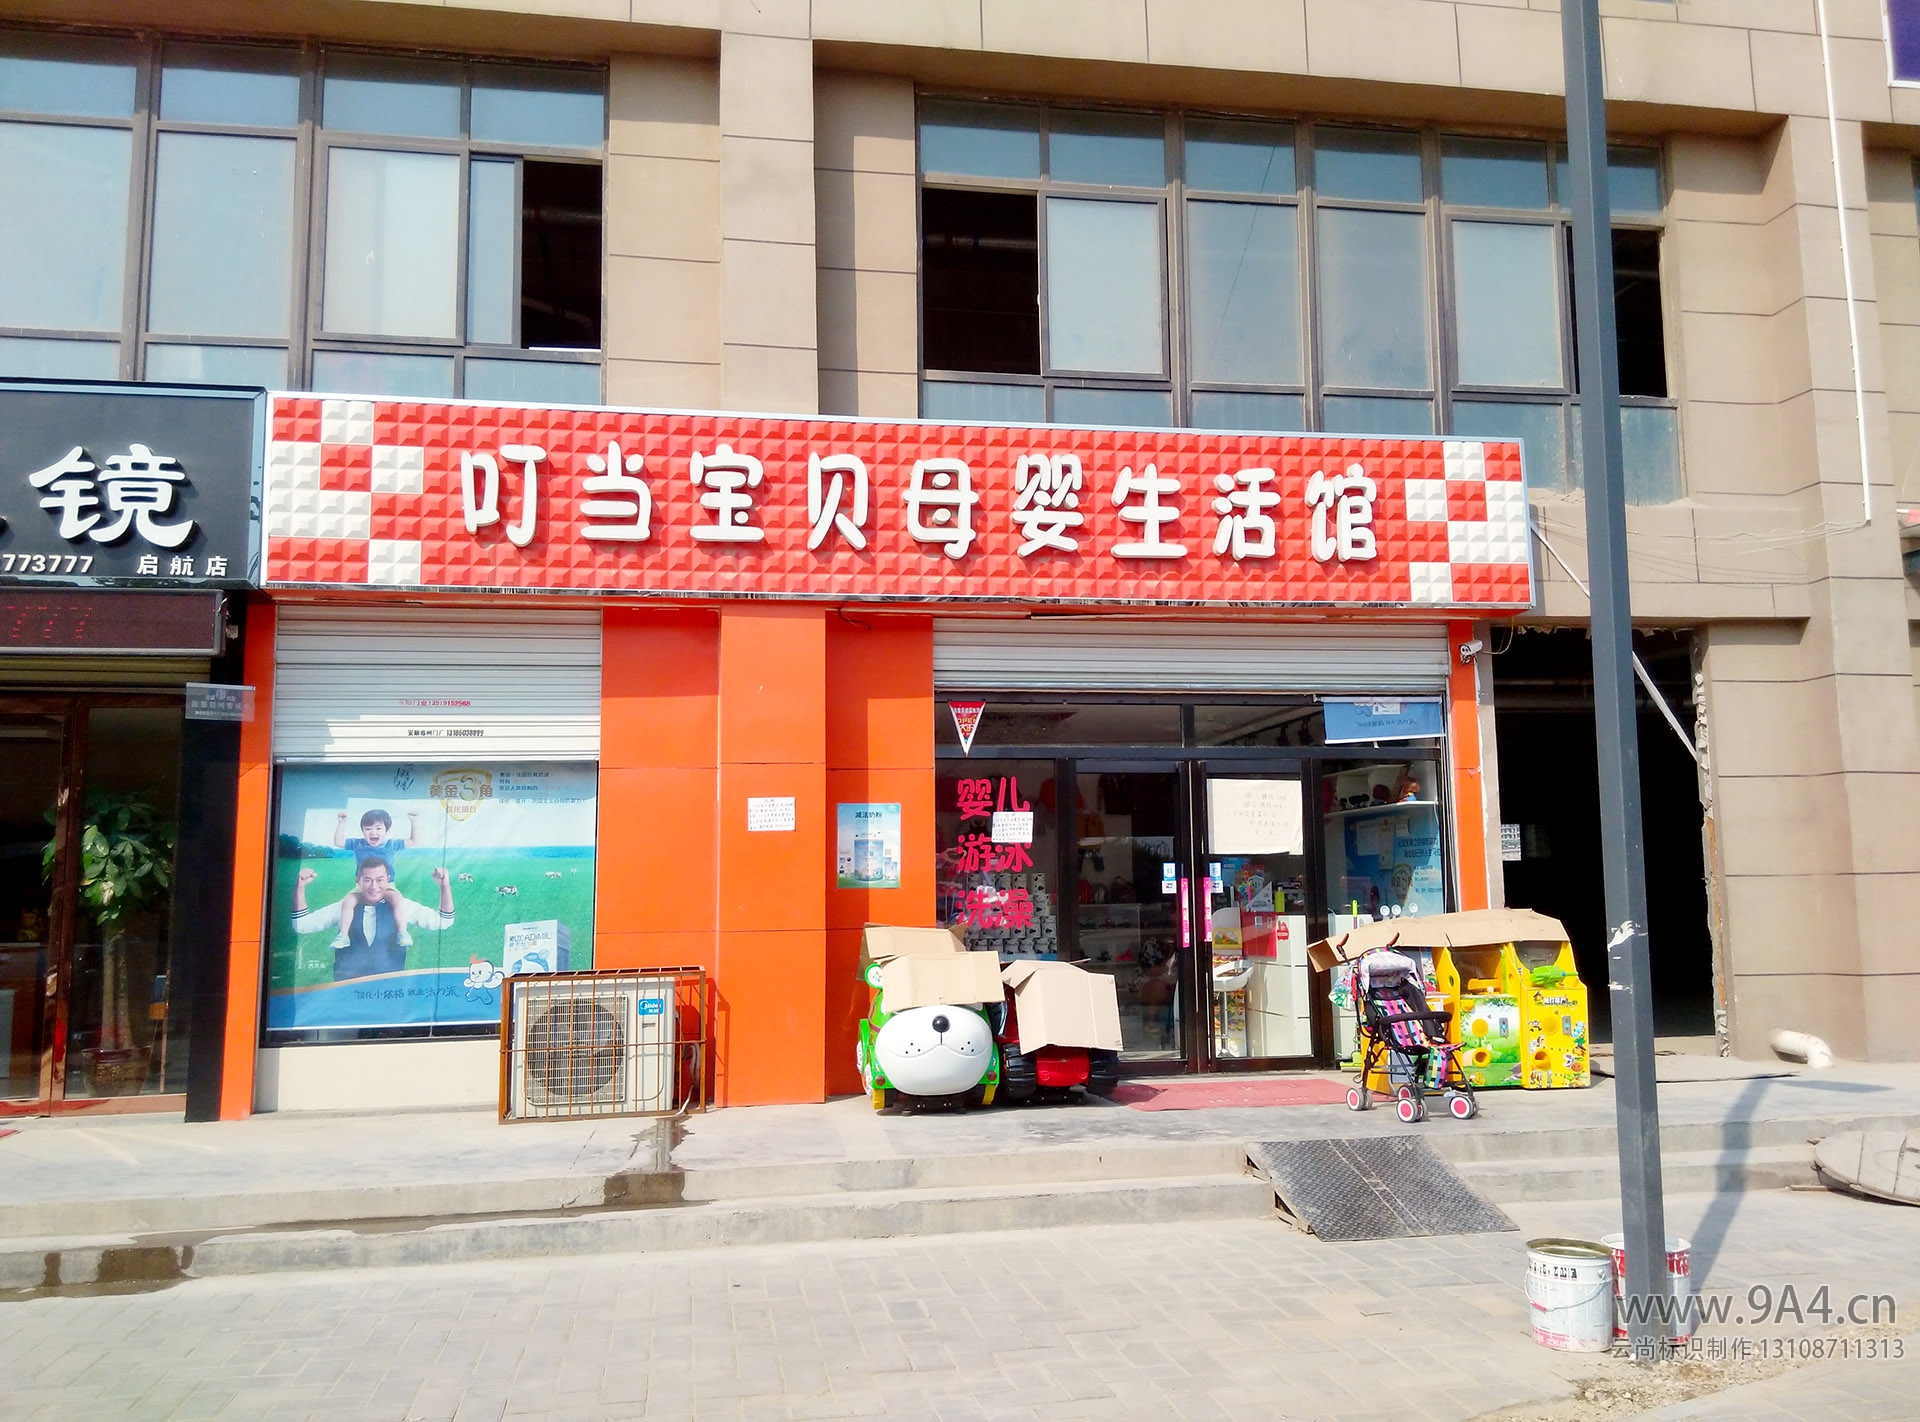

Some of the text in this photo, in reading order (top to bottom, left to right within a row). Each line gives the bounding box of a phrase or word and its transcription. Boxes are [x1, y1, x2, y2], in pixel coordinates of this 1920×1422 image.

[29, 443, 194, 548] 镜
[460, 440, 1378, 563] 叮当宝贝母婴生活馆
[136, 553, 228, 577] 启航店
[956, 776, 1030, 820] 婴儿
[955, 888, 1034, 929] 洗澡
